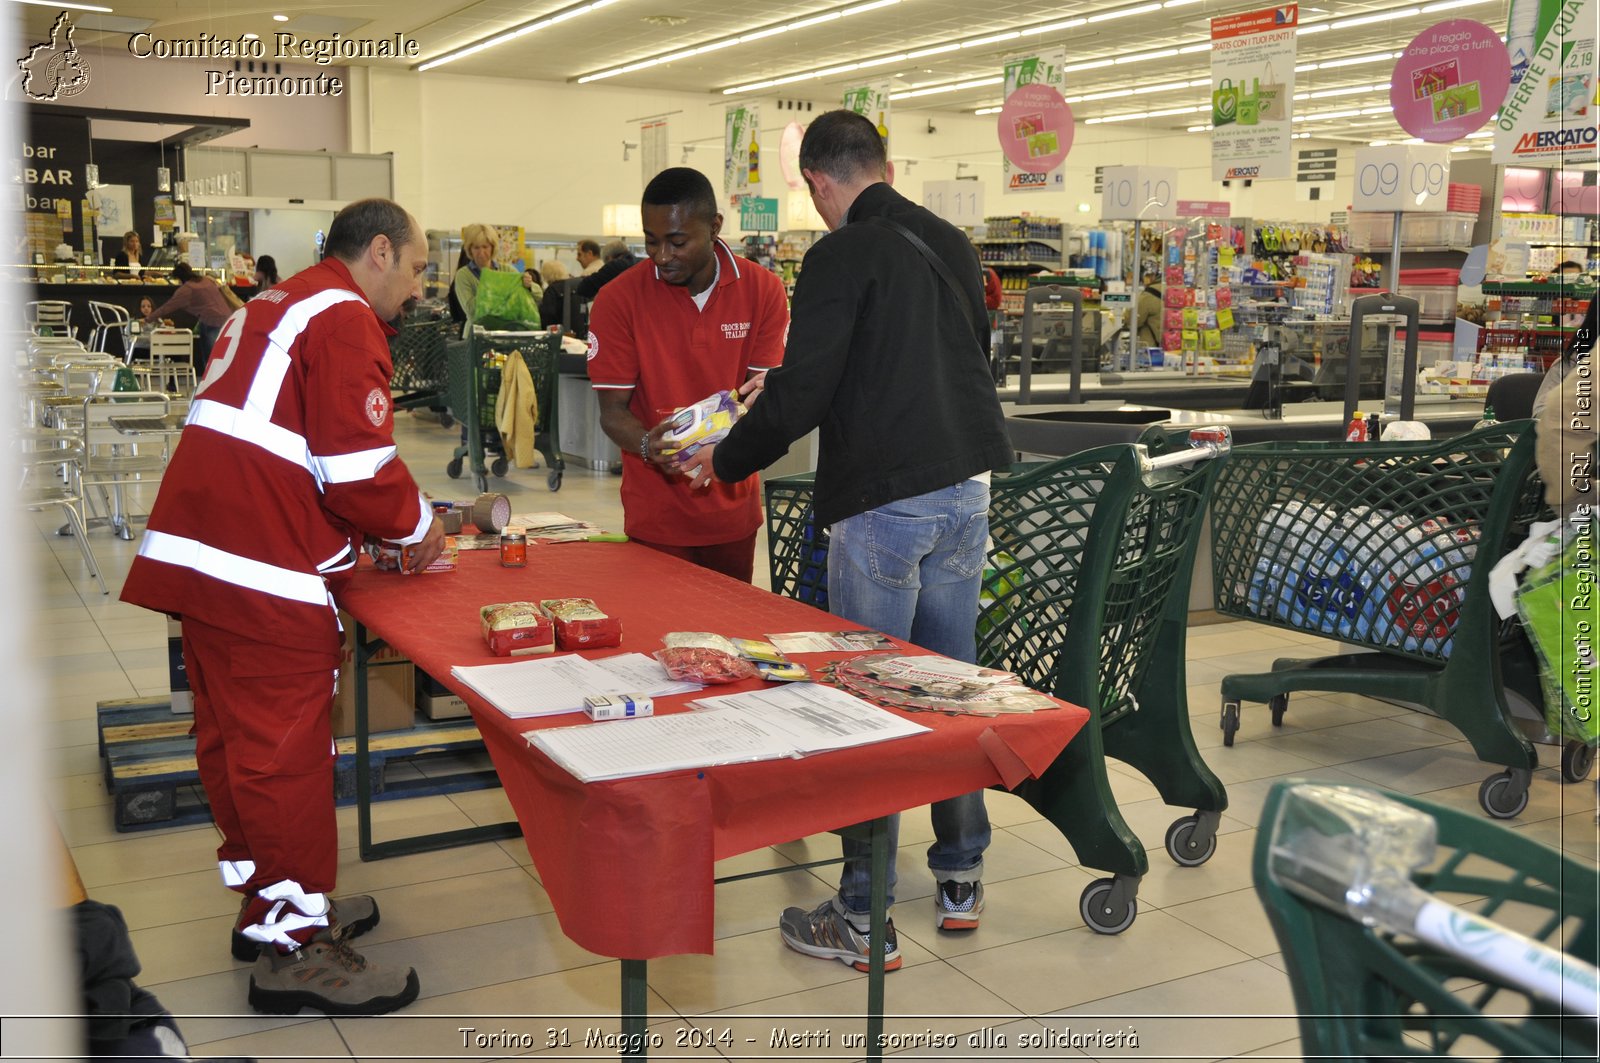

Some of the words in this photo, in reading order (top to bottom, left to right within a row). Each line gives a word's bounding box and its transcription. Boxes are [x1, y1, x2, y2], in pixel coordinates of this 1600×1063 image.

[1233, 39, 1246, 48] CON
[1252, 36, 1268, 46] TUOI
[1269, 32, 1289, 42] PUNTI
[1432, 34, 1437, 43] Il
[1438, 31, 1472, 44] regalo
[1409, 46, 1428, 56] che
[1430, 43, 1459, 56] piace
[1499, 63, 1547, 132] OFFERTE
[1538, 41, 1559, 61] DI
[1552, 0, 1587, 37] QUA
[1513, 126, 1597, 153] MERCATO
[23, 142, 56, 159] bar
[24, 168, 73, 186] BAR
[1010, 172, 1047, 188] MERCATO
[1224, 166, 1260, 179] MERCATO
[1360, 162, 1399, 196] 09
[1410, 162, 1444, 196] 09
[26, 193, 58, 210] bar
[927, 192, 943, 214] 11
[1107, 180, 1132, 208] 10
[1143, 180, 1171, 208] 10
[954, 192, 976, 215] 11
[721, 323, 739, 332] CROCE
